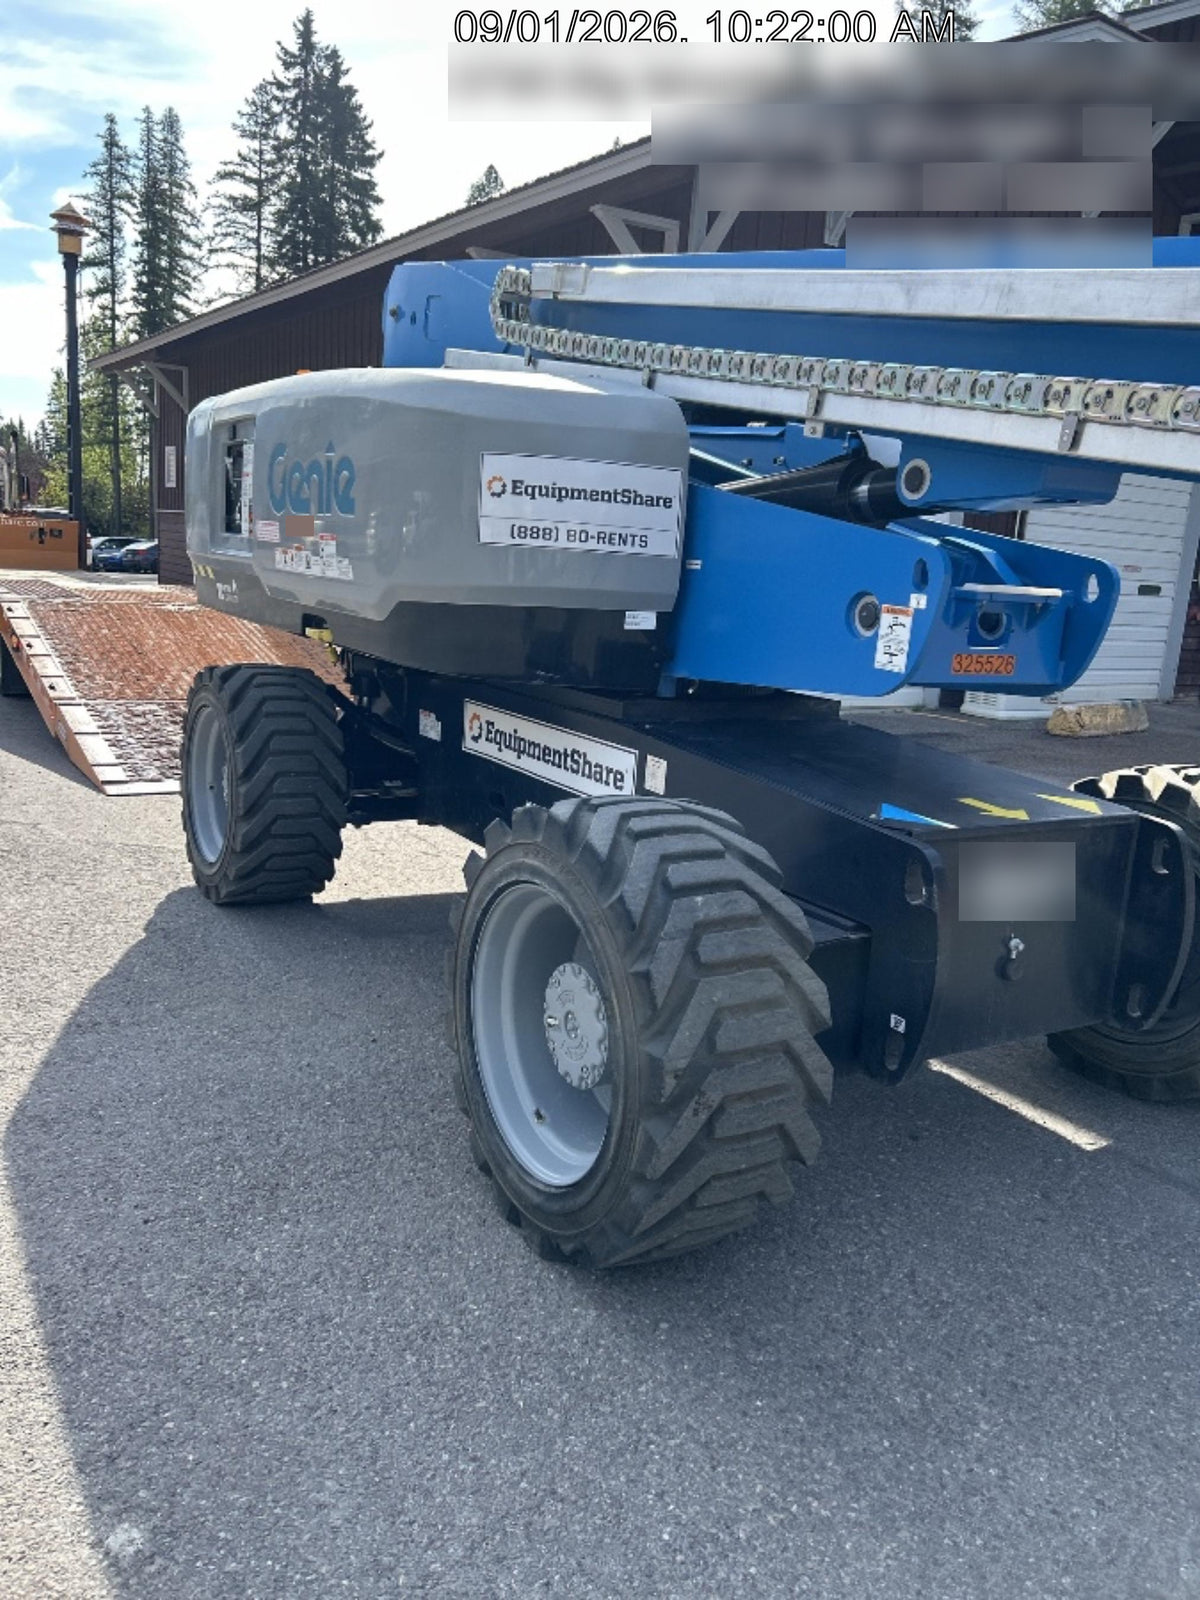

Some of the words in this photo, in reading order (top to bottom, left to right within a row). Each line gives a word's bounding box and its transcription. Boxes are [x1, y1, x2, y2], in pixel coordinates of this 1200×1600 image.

[267, 440, 356, 517] Genie
[510, 479, 674, 509] EquipmentShare
[510, 524, 559, 542] (888)
[952, 653, 1014, 674] 325526
[484, 719, 625, 791] EquipmentShare
